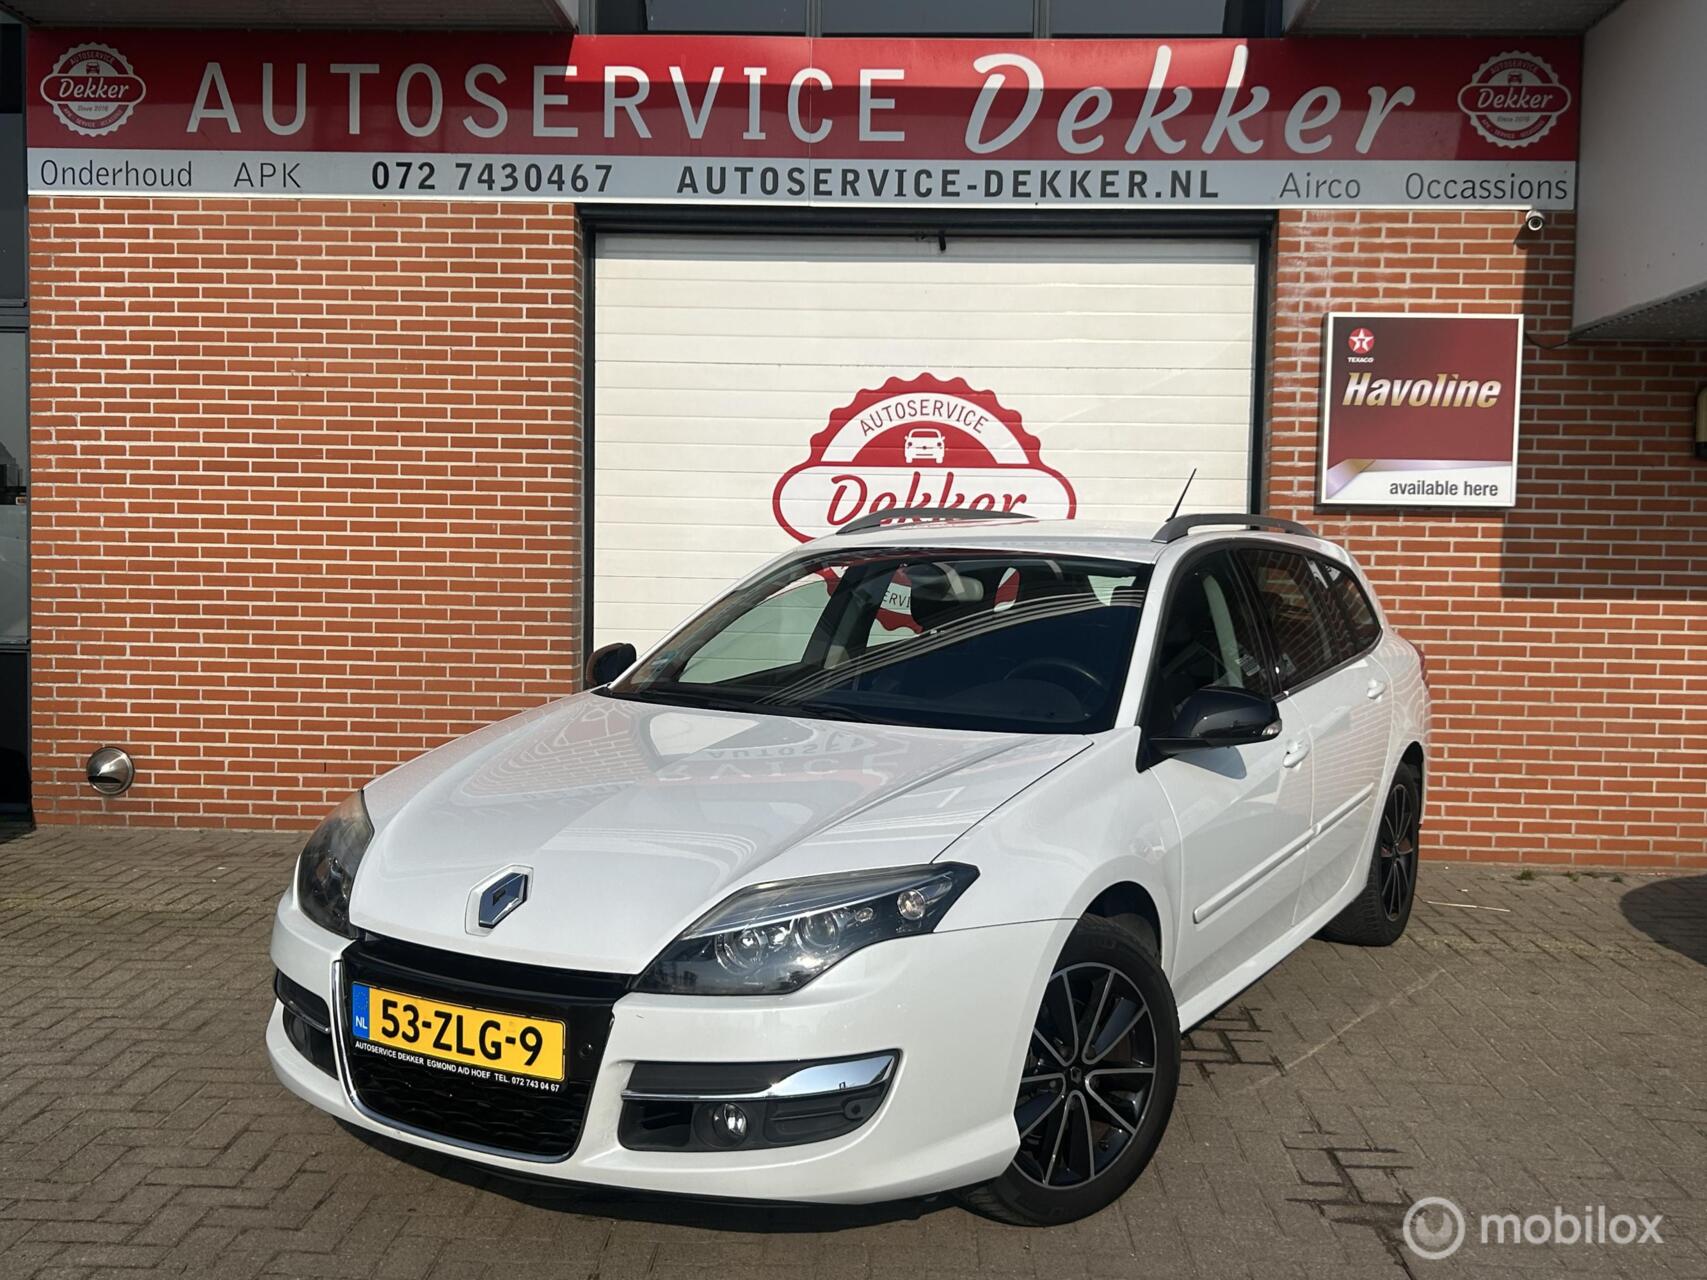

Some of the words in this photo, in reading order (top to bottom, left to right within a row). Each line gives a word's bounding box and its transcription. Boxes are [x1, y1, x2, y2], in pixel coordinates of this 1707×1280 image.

[59, 76, 130, 98] Dekker
[186, 61, 906, 144] AUTOSERVICE
[964, 44, 1415, 154] Dekker
[1477, 86, 1554, 108] Dekker
[40, 159, 193, 188] Onderhoud
[233, 162, 301, 189] APK
[371, 161, 437, 191] 072
[455, 162, 614, 192] 7430467
[677, 164, 1218, 198] AUTOSERVICE-DEKKER.NL
[1279, 172, 1361, 200] Airco
[1404, 172, 1567, 201] Occassions
[1342, 372, 1502, 408] Havoline
[859, 398, 989, 437] AUTOSERVICE
[1389, 480, 1458, 496] available
[1463, 481, 1499, 497] here
[355, 1015, 368, 1030] NL
[381, 998, 543, 1067] 53-ZLG-9
[355, 1040, 397, 1059] AUTOSERVICE
[397, 1052, 424, 1065] DEKKER
[426, 1059, 457, 1072] EGMOND
[457, 1066, 470, 1075] A/D
[471, 1068, 491, 1079] HOEF
[494, 1073, 510, 1083] TEL.
[511, 1076, 525, 1086] 072
[526, 1079, 539, 1088] 743
[540, 1081, 549, 1090] 04
[550, 1083, 560, 1092] 67
